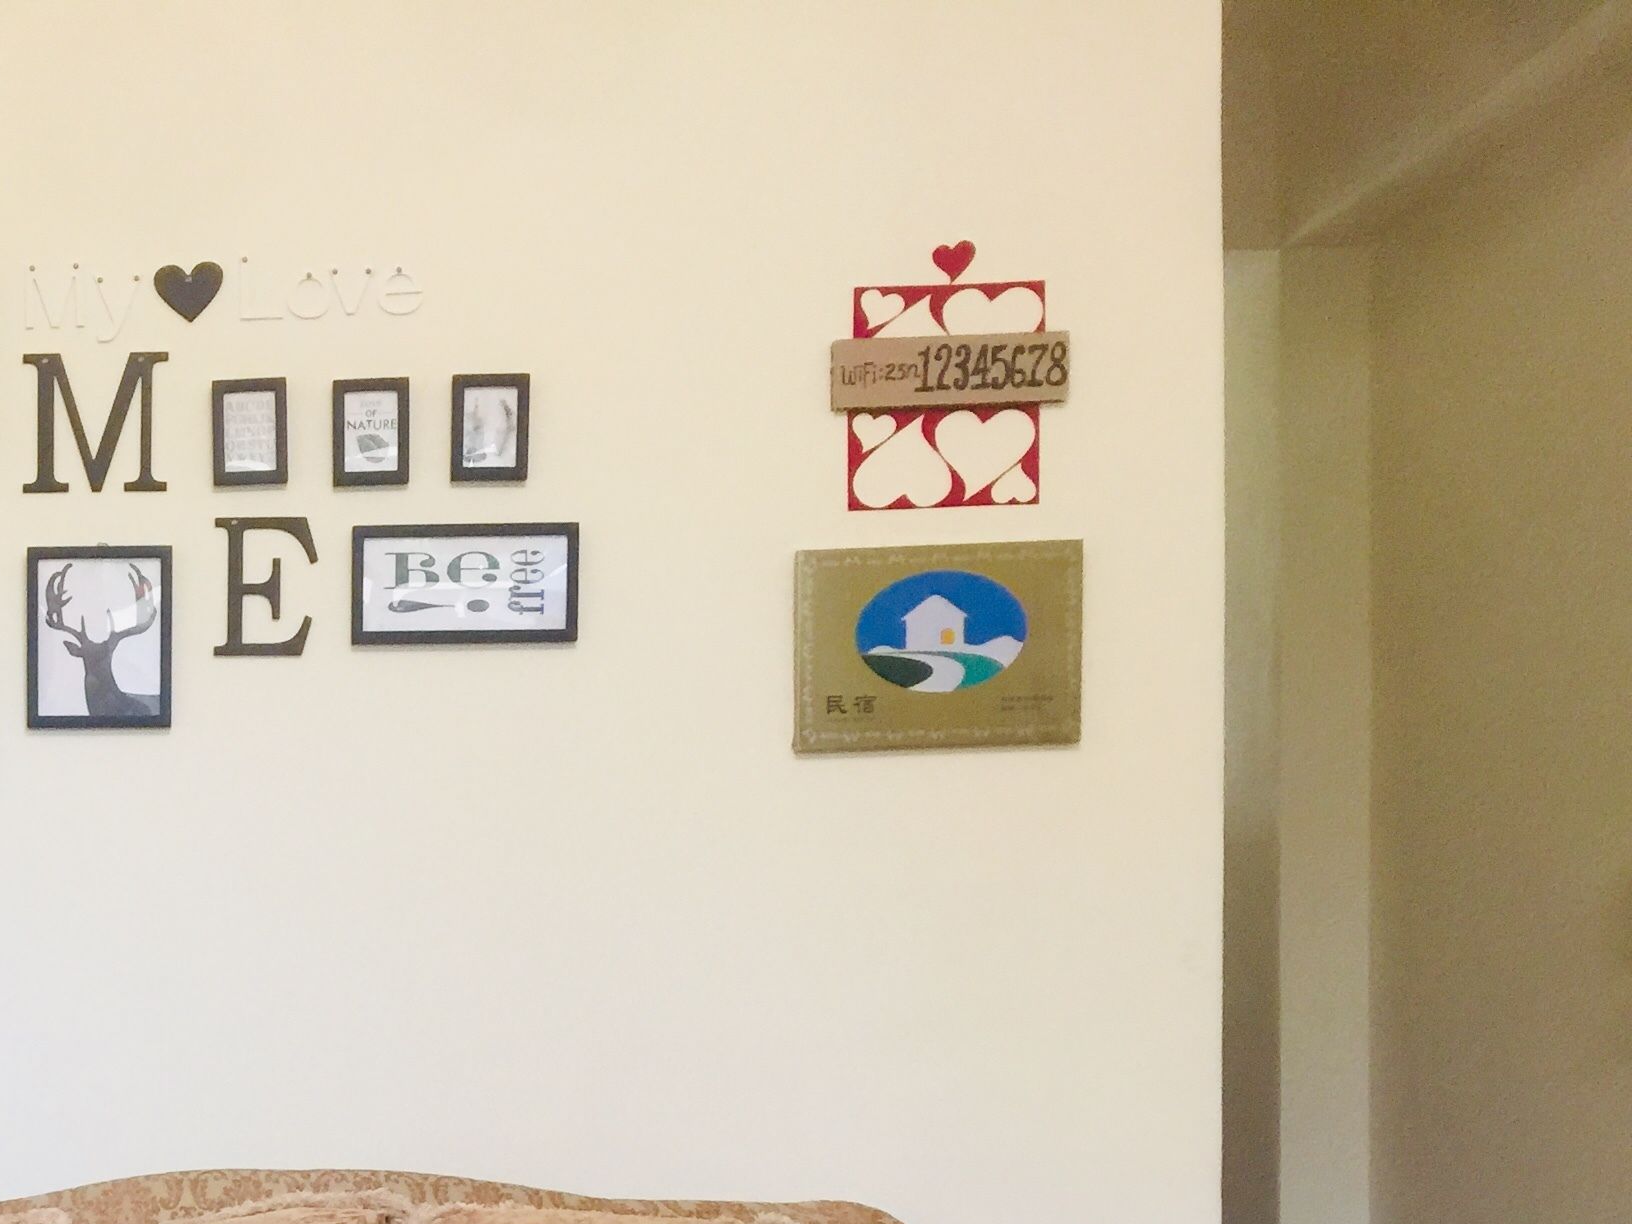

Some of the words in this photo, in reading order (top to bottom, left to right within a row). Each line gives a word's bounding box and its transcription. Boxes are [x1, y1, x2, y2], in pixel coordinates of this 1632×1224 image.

[239, 256, 424, 321] Love
[346, 418, 399, 432] NATURE
[384, 550, 501, 590] Be
[507, 549, 546, 616] free
[825, 694, 878, 715] 民宿
